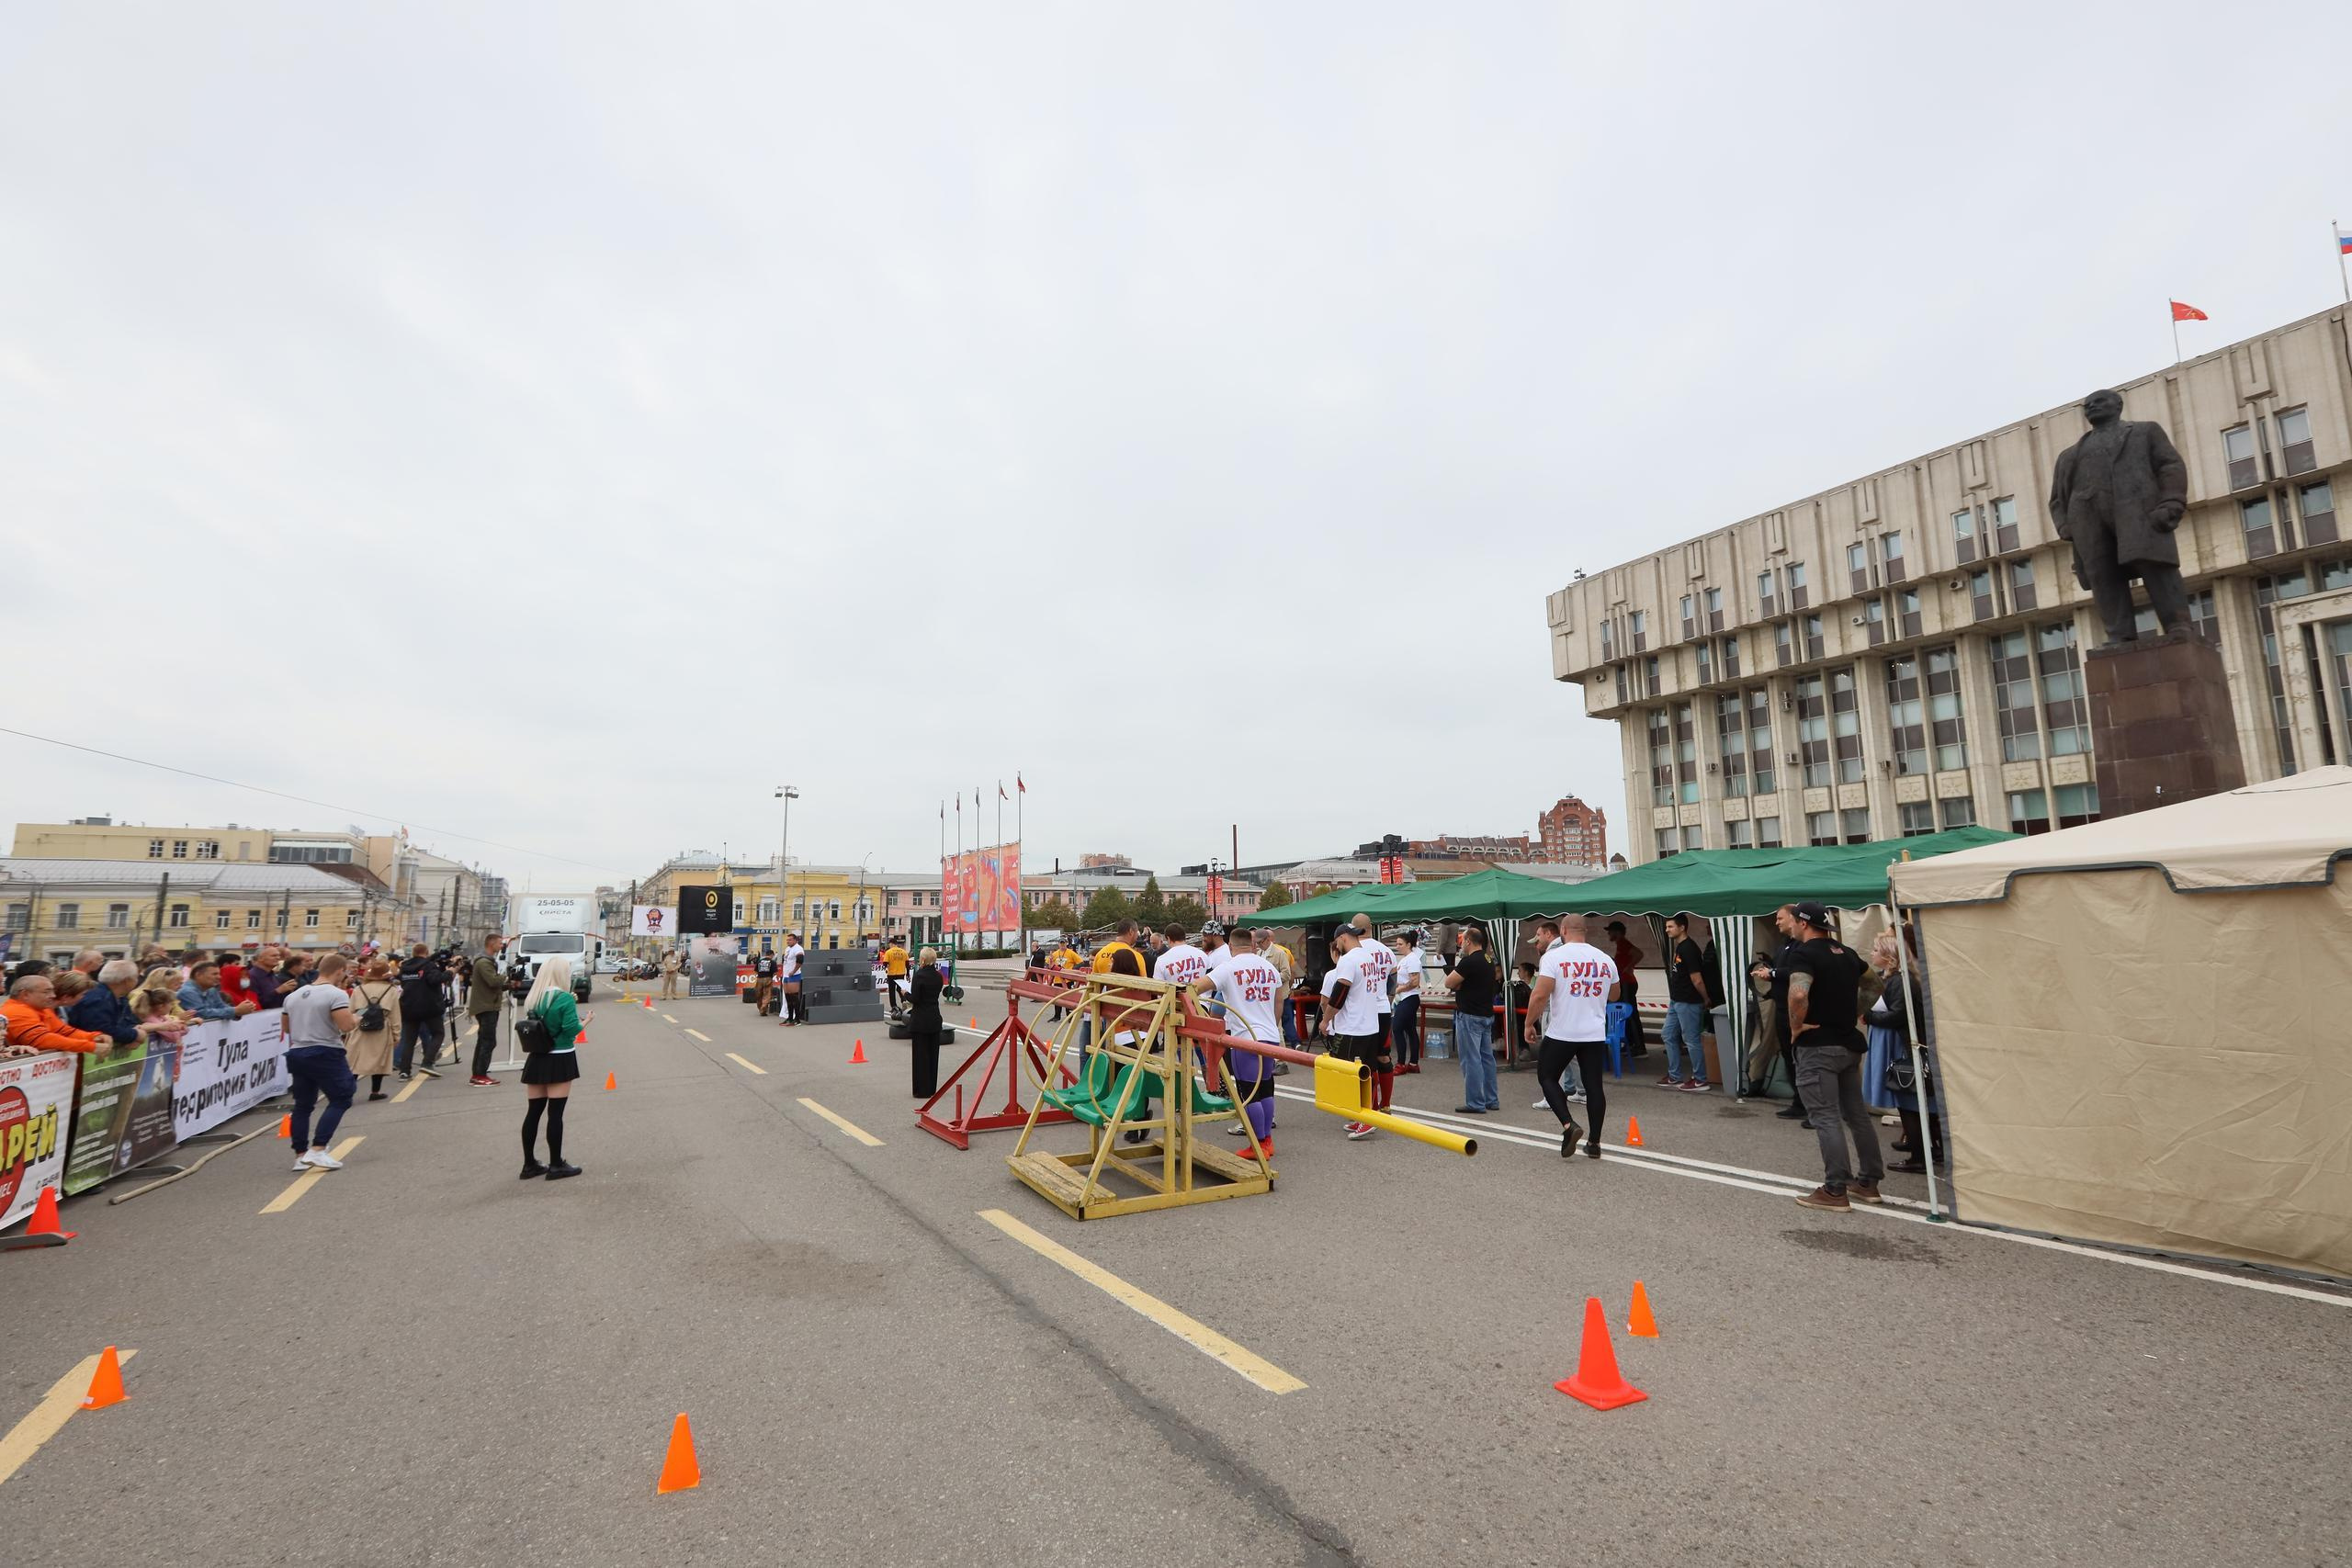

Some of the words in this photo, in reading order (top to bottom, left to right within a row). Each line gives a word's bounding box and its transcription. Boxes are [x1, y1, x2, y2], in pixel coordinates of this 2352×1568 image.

[1166, 956, 1205, 976] ТУЛА
[1234, 966, 1276, 986] ТУЛА
[1559, 959, 1611, 978] ТУЛА
[1570, 979, 1603, 998] 875
[217, 1038, 249, 1073] Тула
[173, 1073, 246, 1123] территория
[250, 1055, 278, 1089] СИЛЫ
